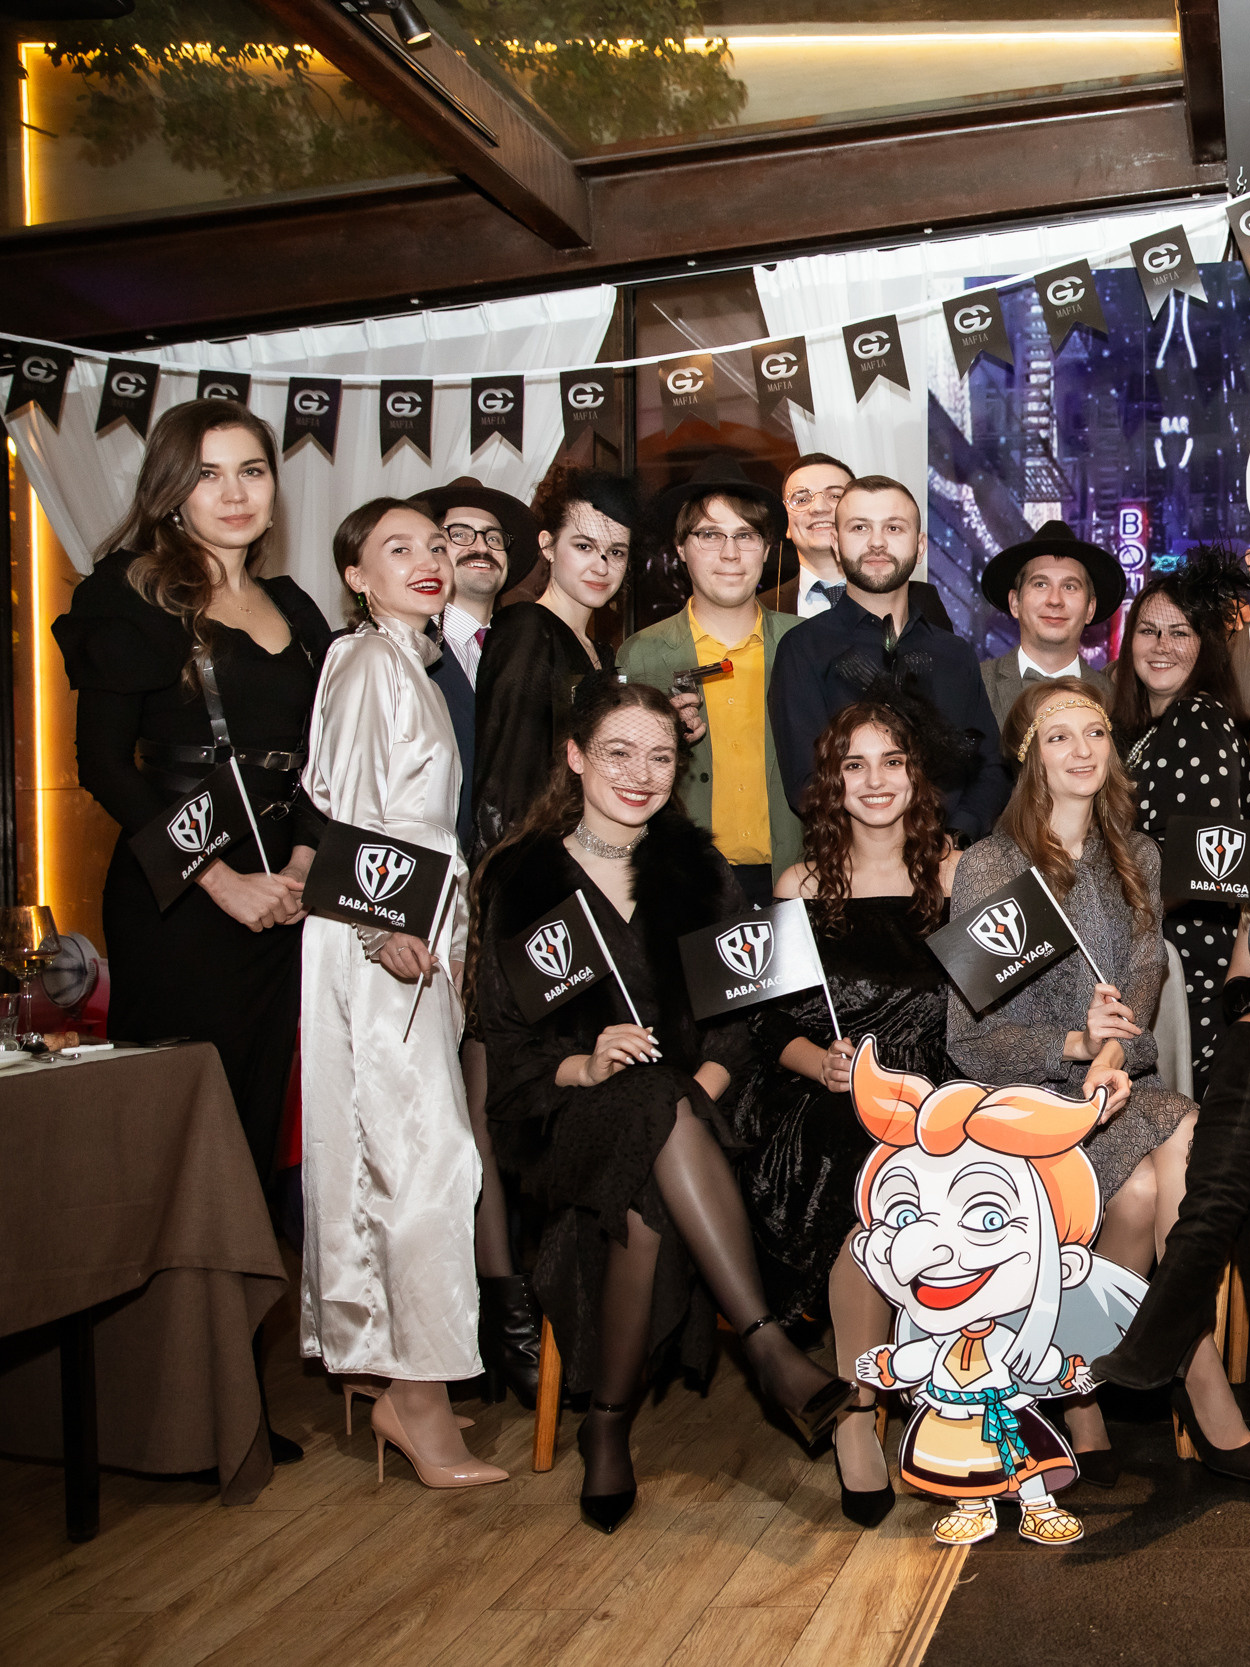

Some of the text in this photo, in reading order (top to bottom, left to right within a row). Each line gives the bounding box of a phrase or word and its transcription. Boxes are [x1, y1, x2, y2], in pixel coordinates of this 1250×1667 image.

[1153, 271, 1179, 286] MAFIA
[1056, 303, 1083, 319] MAFIA
[962, 333, 989, 347] MAFIA
[860, 358, 887, 372] MAFIA
[767, 380, 793, 392] MAFIA
[672, 395, 698, 406] MAFIA
[481, 415, 506, 426] MAFIA
[572, 410, 598, 421] MAFIA
[182, 831, 230, 880] BABA-YAGA
[1190, 880, 1249, 895] BABA-YAGA
[338, 895, 406, 923] BABA-YAGA
[995, 940, 1053, 983] BABA-YAGA
[544, 966, 593, 1002] BABA-YAGA
[725, 975, 783, 1000] BABA-YAG
